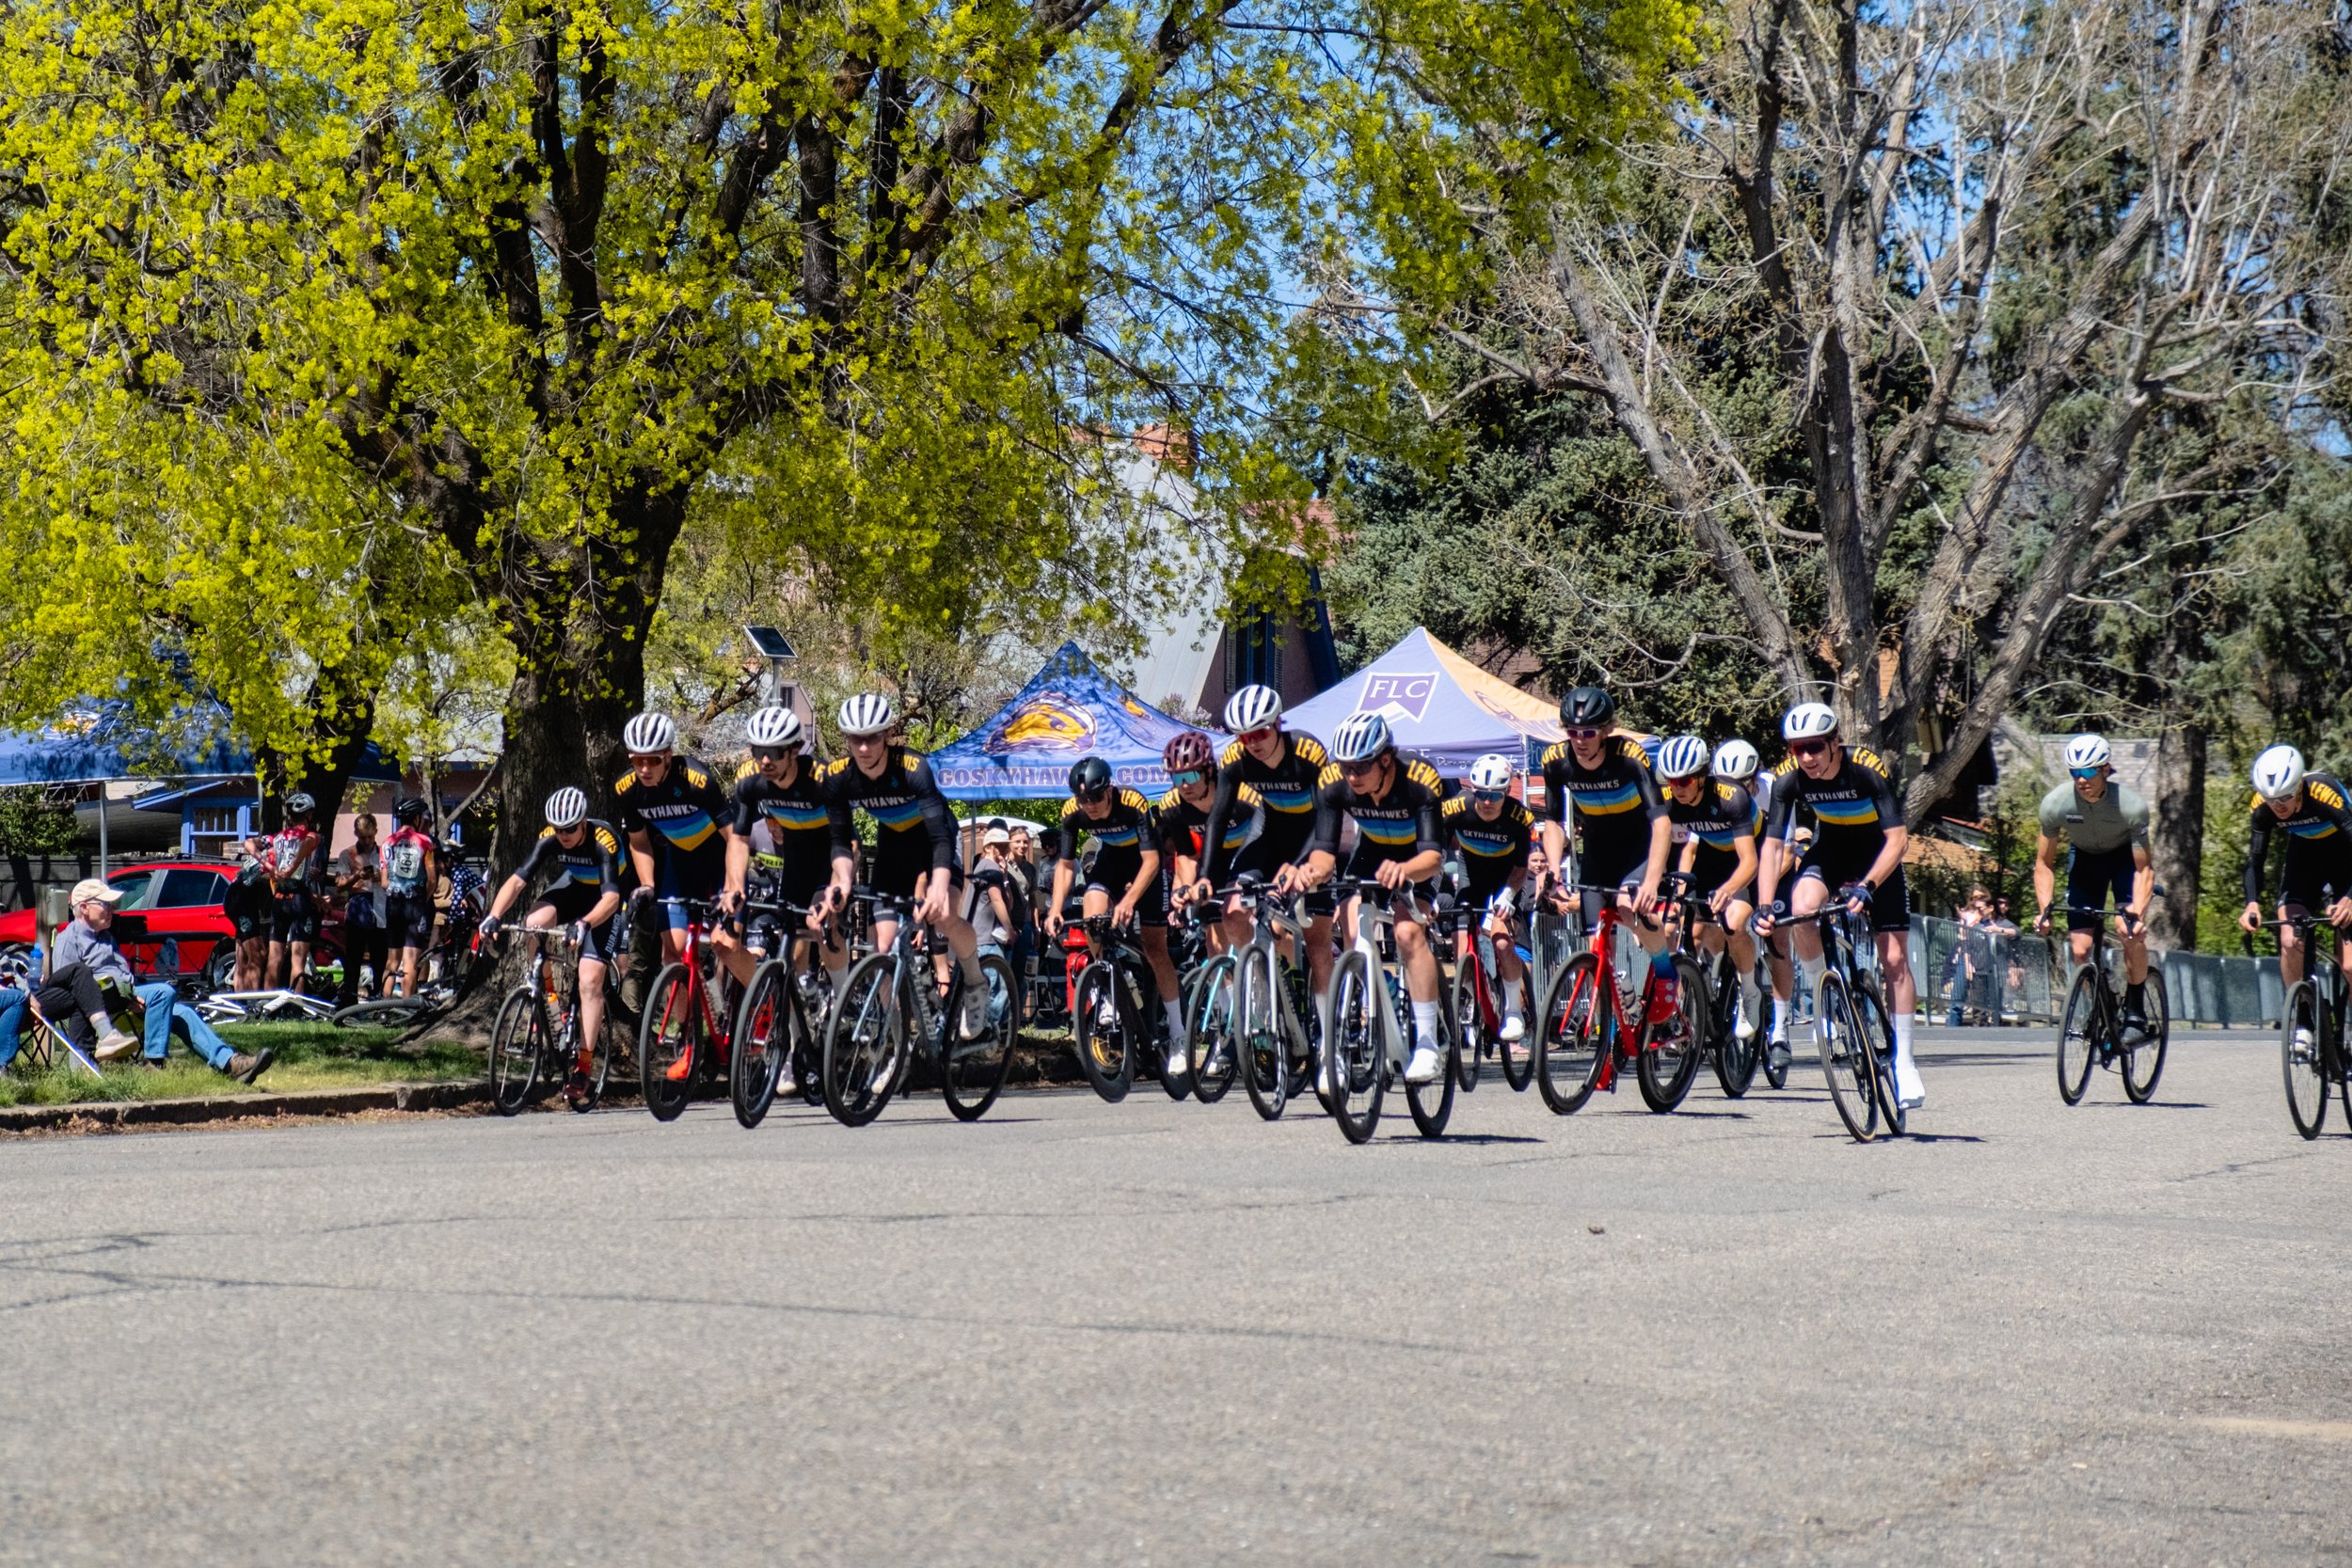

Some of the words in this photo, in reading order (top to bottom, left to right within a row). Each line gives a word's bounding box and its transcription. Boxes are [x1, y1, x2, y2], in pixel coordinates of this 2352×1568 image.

[1369, 679, 1429, 699] FLC
[1295, 736, 1327, 768] LEWI
[1851, 746, 1889, 779] LEWIS
[735, 757, 760, 784] ORT
[828, 756, 850, 776] FORT
[900, 754, 920, 772] WIS
[615, 770, 637, 795] FORT
[685, 768, 707, 789] WIS
[937, 764, 1170, 789] GOSKYHAW.COM
[1248, 781, 1301, 792] SKYHAWKS
[1318, 762, 1343, 790] FOR
[1406, 759, 1443, 799] LEWIS
[1567, 779, 1620, 791] SKYHAWKS
[1061, 797, 1082, 817] FOR
[1120, 789, 1148, 815] LEWIS
[1159, 788, 1181, 813] ORT
[1237, 781, 1263, 807] WIS
[1715, 783, 1738, 801] EWIS
[1804, 789, 1858, 802] SKYHAWKS
[2310, 781, 2344, 810] LEWIS
[637, 803, 699, 819] SKYHAWKS
[1350, 807, 1409, 819] SKYHAWKS
[1441, 796, 1467, 818] FORT
[1509, 804, 1535, 829] LEW
[539, 826, 556, 840] FOR
[1462, 829, 1508, 843] SKYHAWKS
[400, 852, 413, 874] 464
[557, 854, 594, 865] SKYHAWKS
